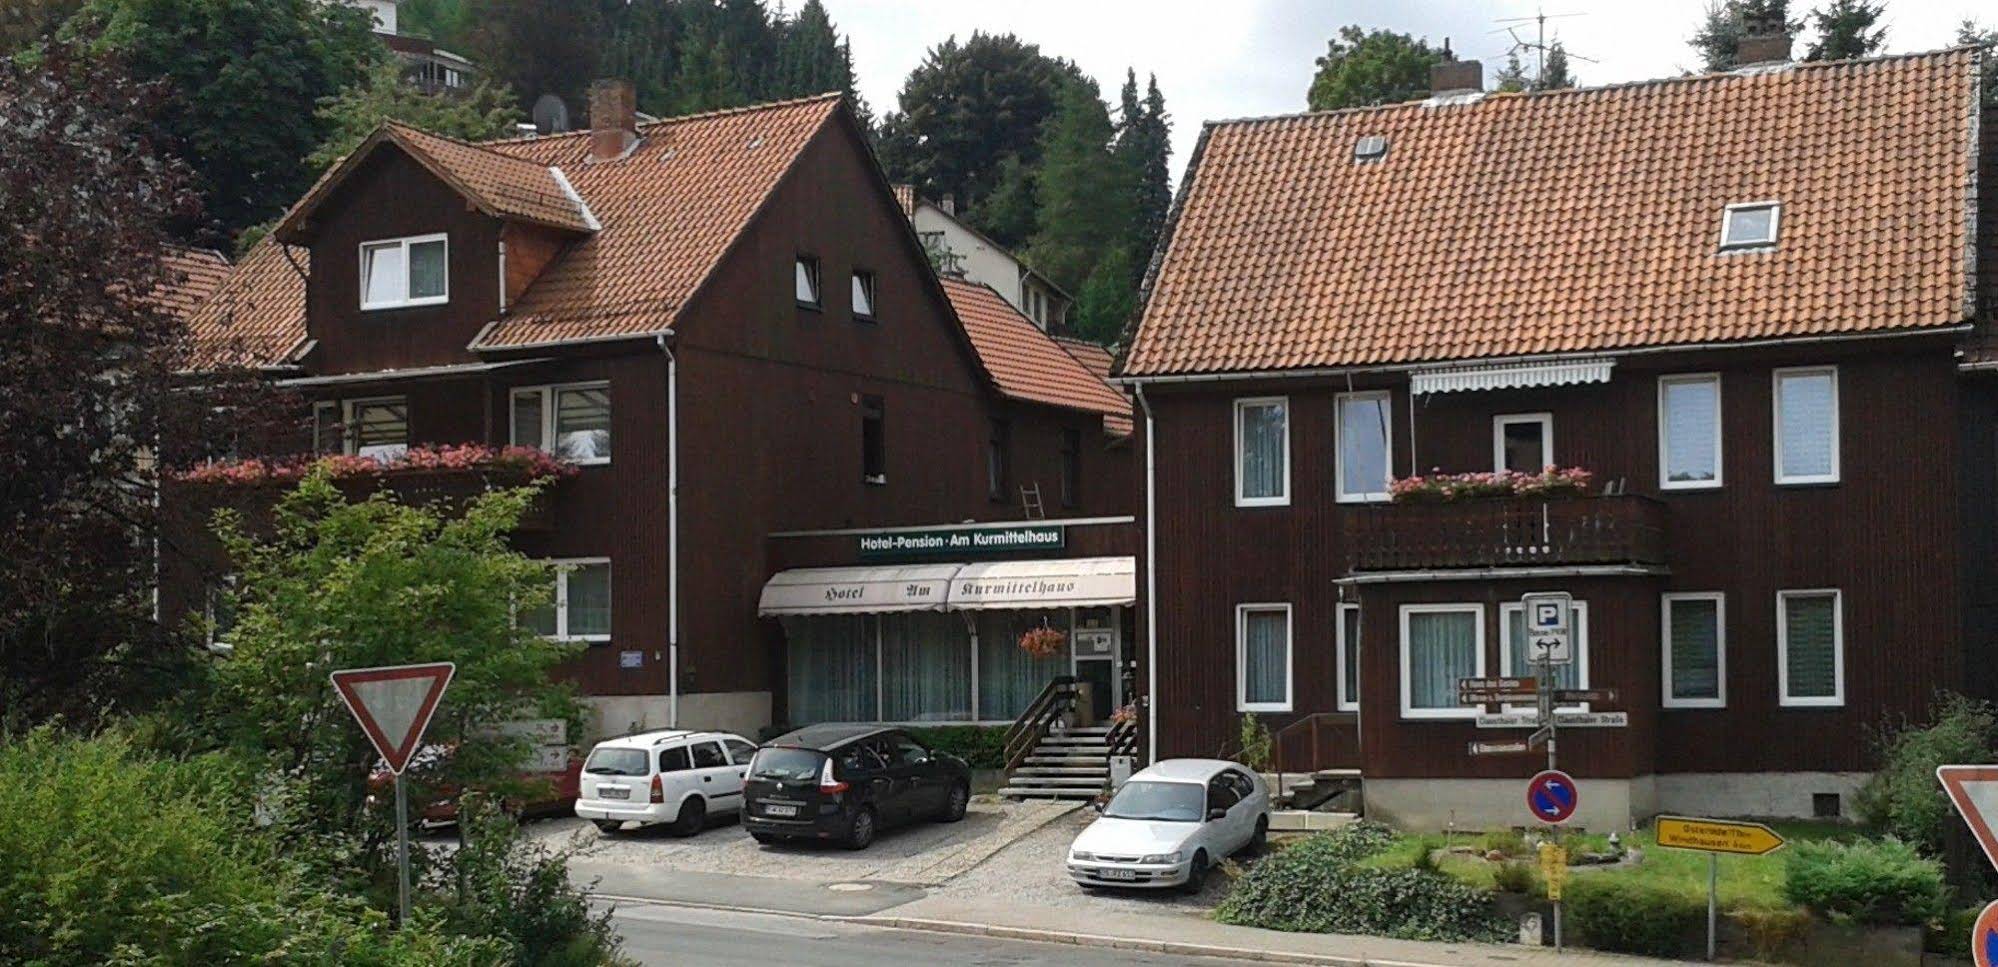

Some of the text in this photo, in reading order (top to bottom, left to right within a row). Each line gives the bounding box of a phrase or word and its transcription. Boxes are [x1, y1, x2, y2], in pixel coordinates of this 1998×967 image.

[860, 529, 1058, 550] Hotel-Pension Am Kurmittelhaus
[824, 581, 1075, 601] Hotel Am Kurmittelhaus
[1539, 606, 1557, 623] P
